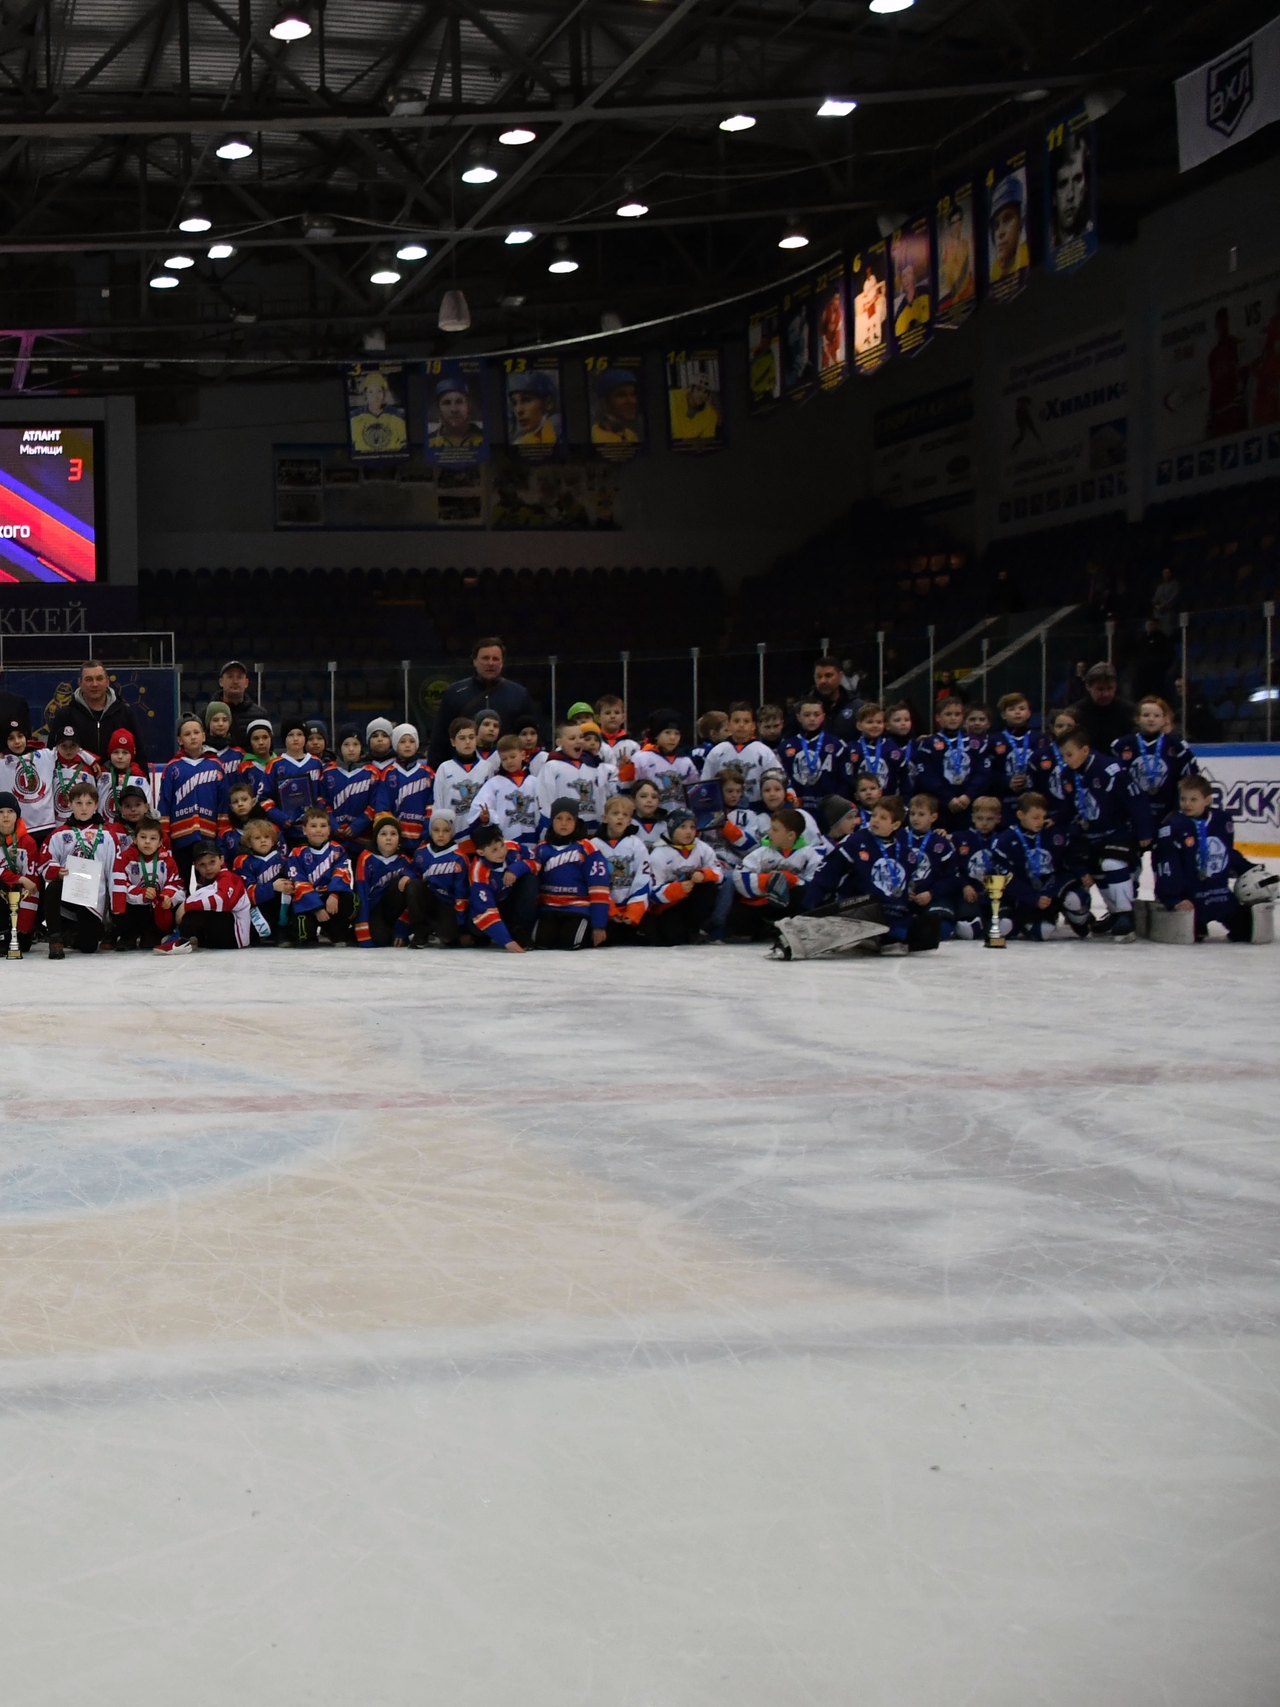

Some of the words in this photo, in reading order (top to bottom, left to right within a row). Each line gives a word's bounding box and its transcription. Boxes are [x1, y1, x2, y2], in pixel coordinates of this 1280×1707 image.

[503, 358, 528, 373] 13
[22, 430, 62, 441] АТЛАНТ
[19, 444, 63, 456] Мытищи
[67, 458, 83, 482] 3
